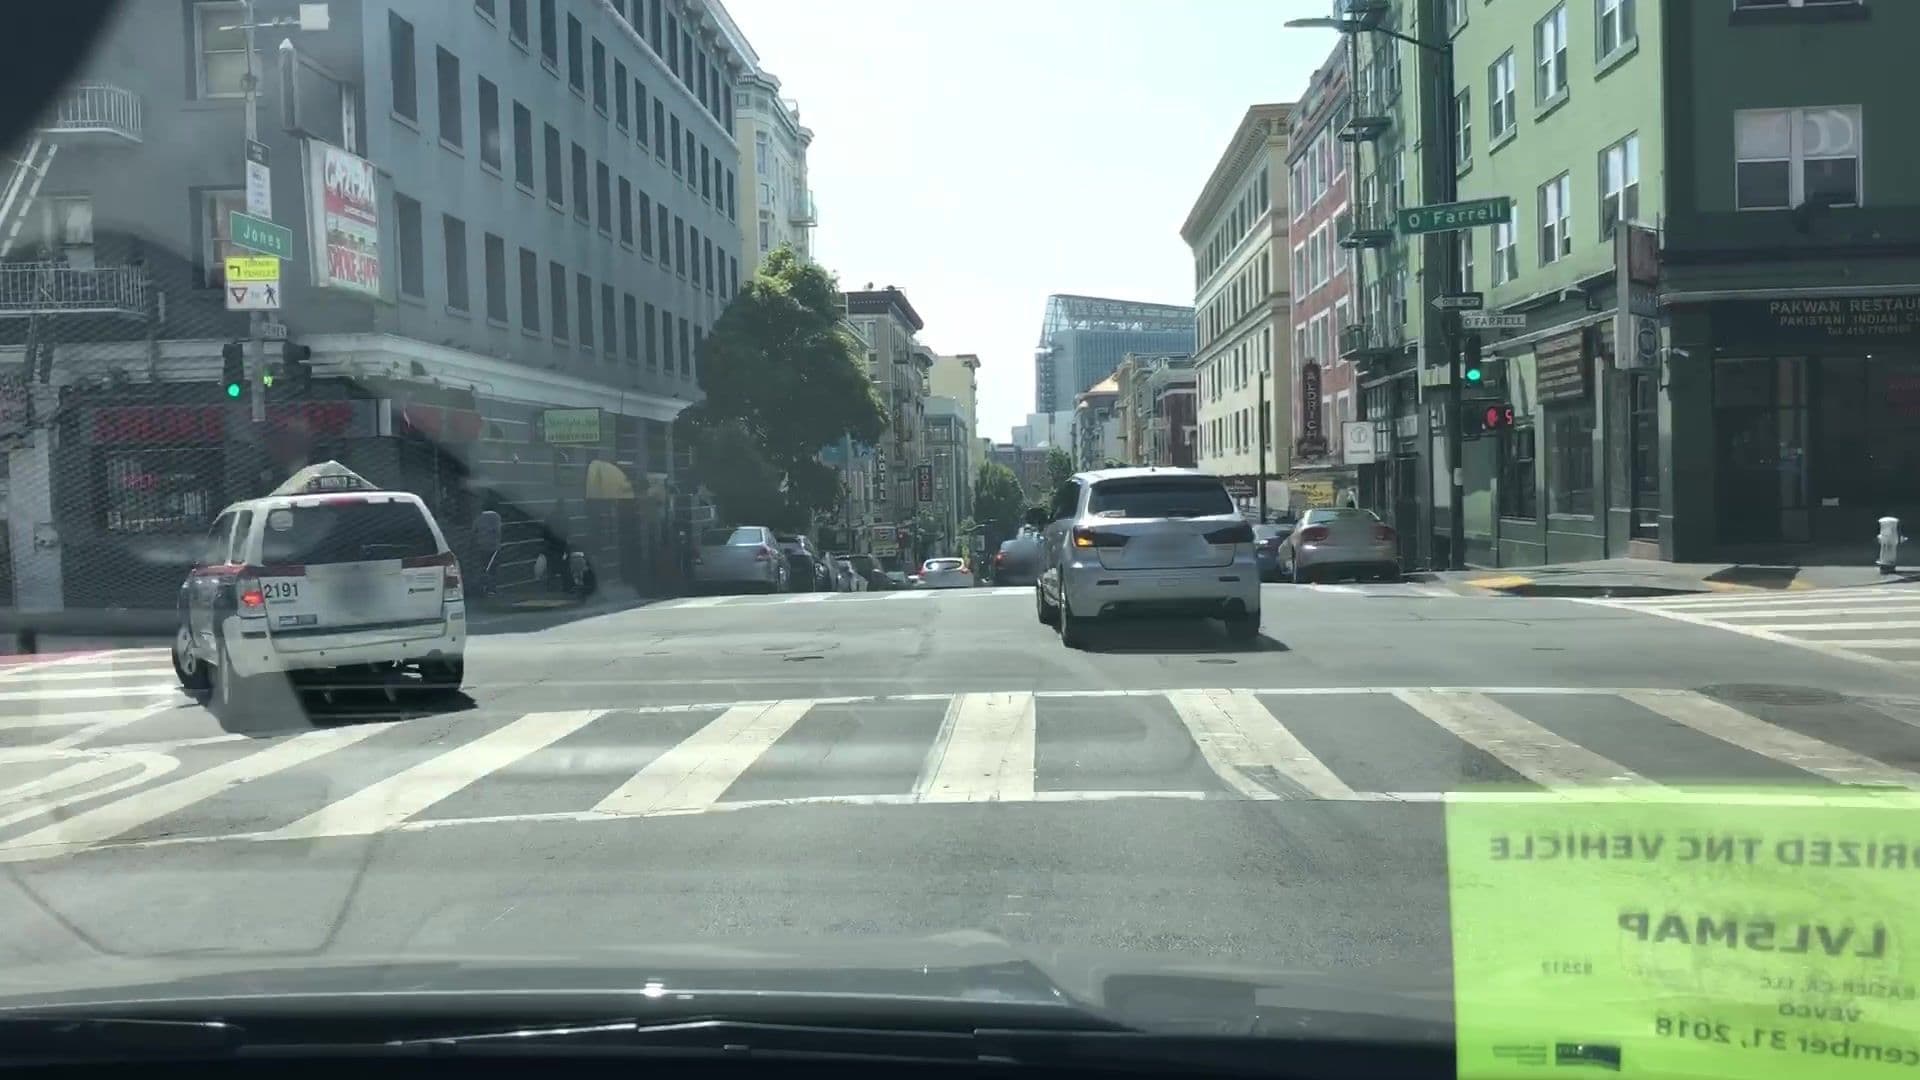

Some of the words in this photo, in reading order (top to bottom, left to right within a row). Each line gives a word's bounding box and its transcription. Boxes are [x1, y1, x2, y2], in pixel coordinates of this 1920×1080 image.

[1408, 202, 1501, 228] O'Farrell
[243, 225, 281, 250] Jones
[1770, 300, 1841, 315] PAKWAN
[1780, 314, 1845, 326] PAKISTANI
[1854, 312, 1897, 325] INDIAN
[1306, 373, 1317, 439] ALDRICH
[1504, 408, 1513, 425] 5
[877, 453, 886, 501] HOTEL
[264, 582, 299, 598] 2191
